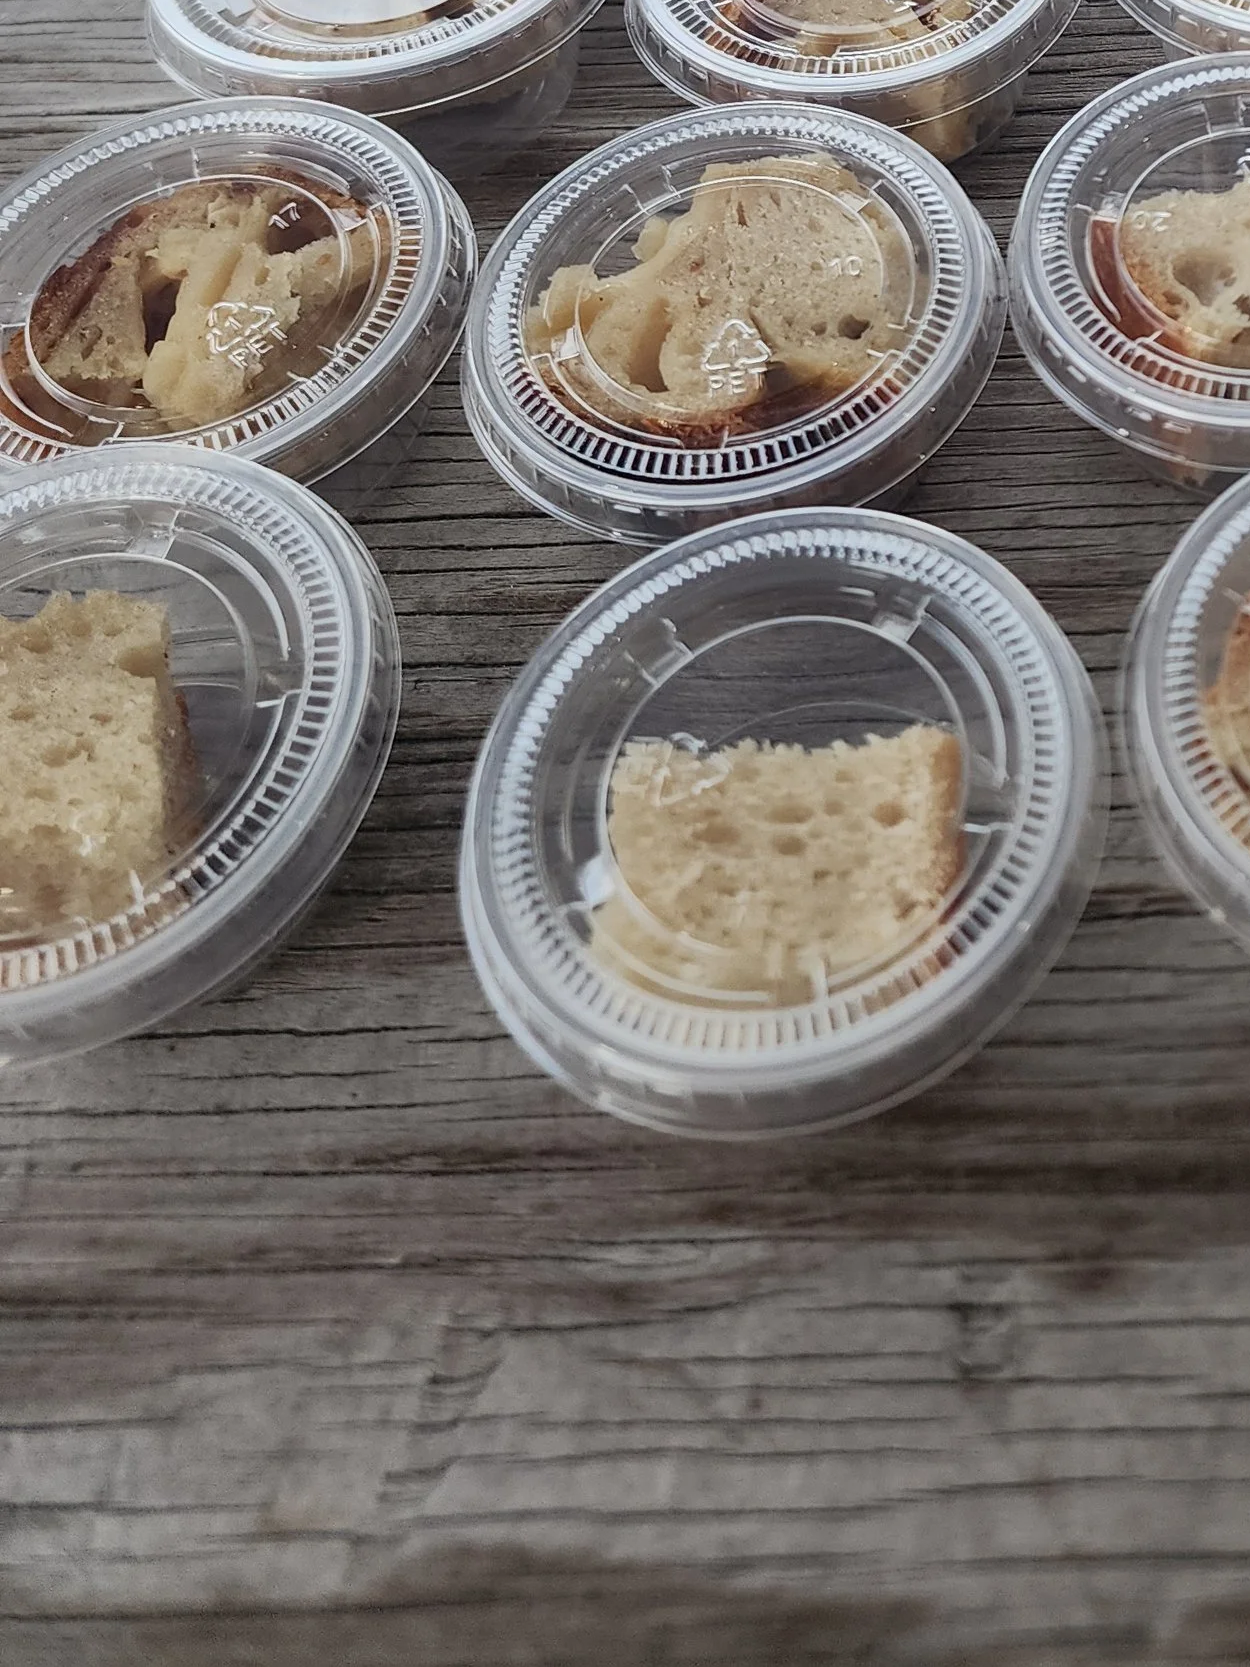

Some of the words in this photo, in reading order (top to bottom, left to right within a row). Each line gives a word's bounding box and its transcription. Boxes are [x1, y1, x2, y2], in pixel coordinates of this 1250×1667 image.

[268, 202, 301, 230] 17
[828, 255, 863, 277] 10
[228, 321, 288, 370] PET
[709, 367, 769, 398] PET
